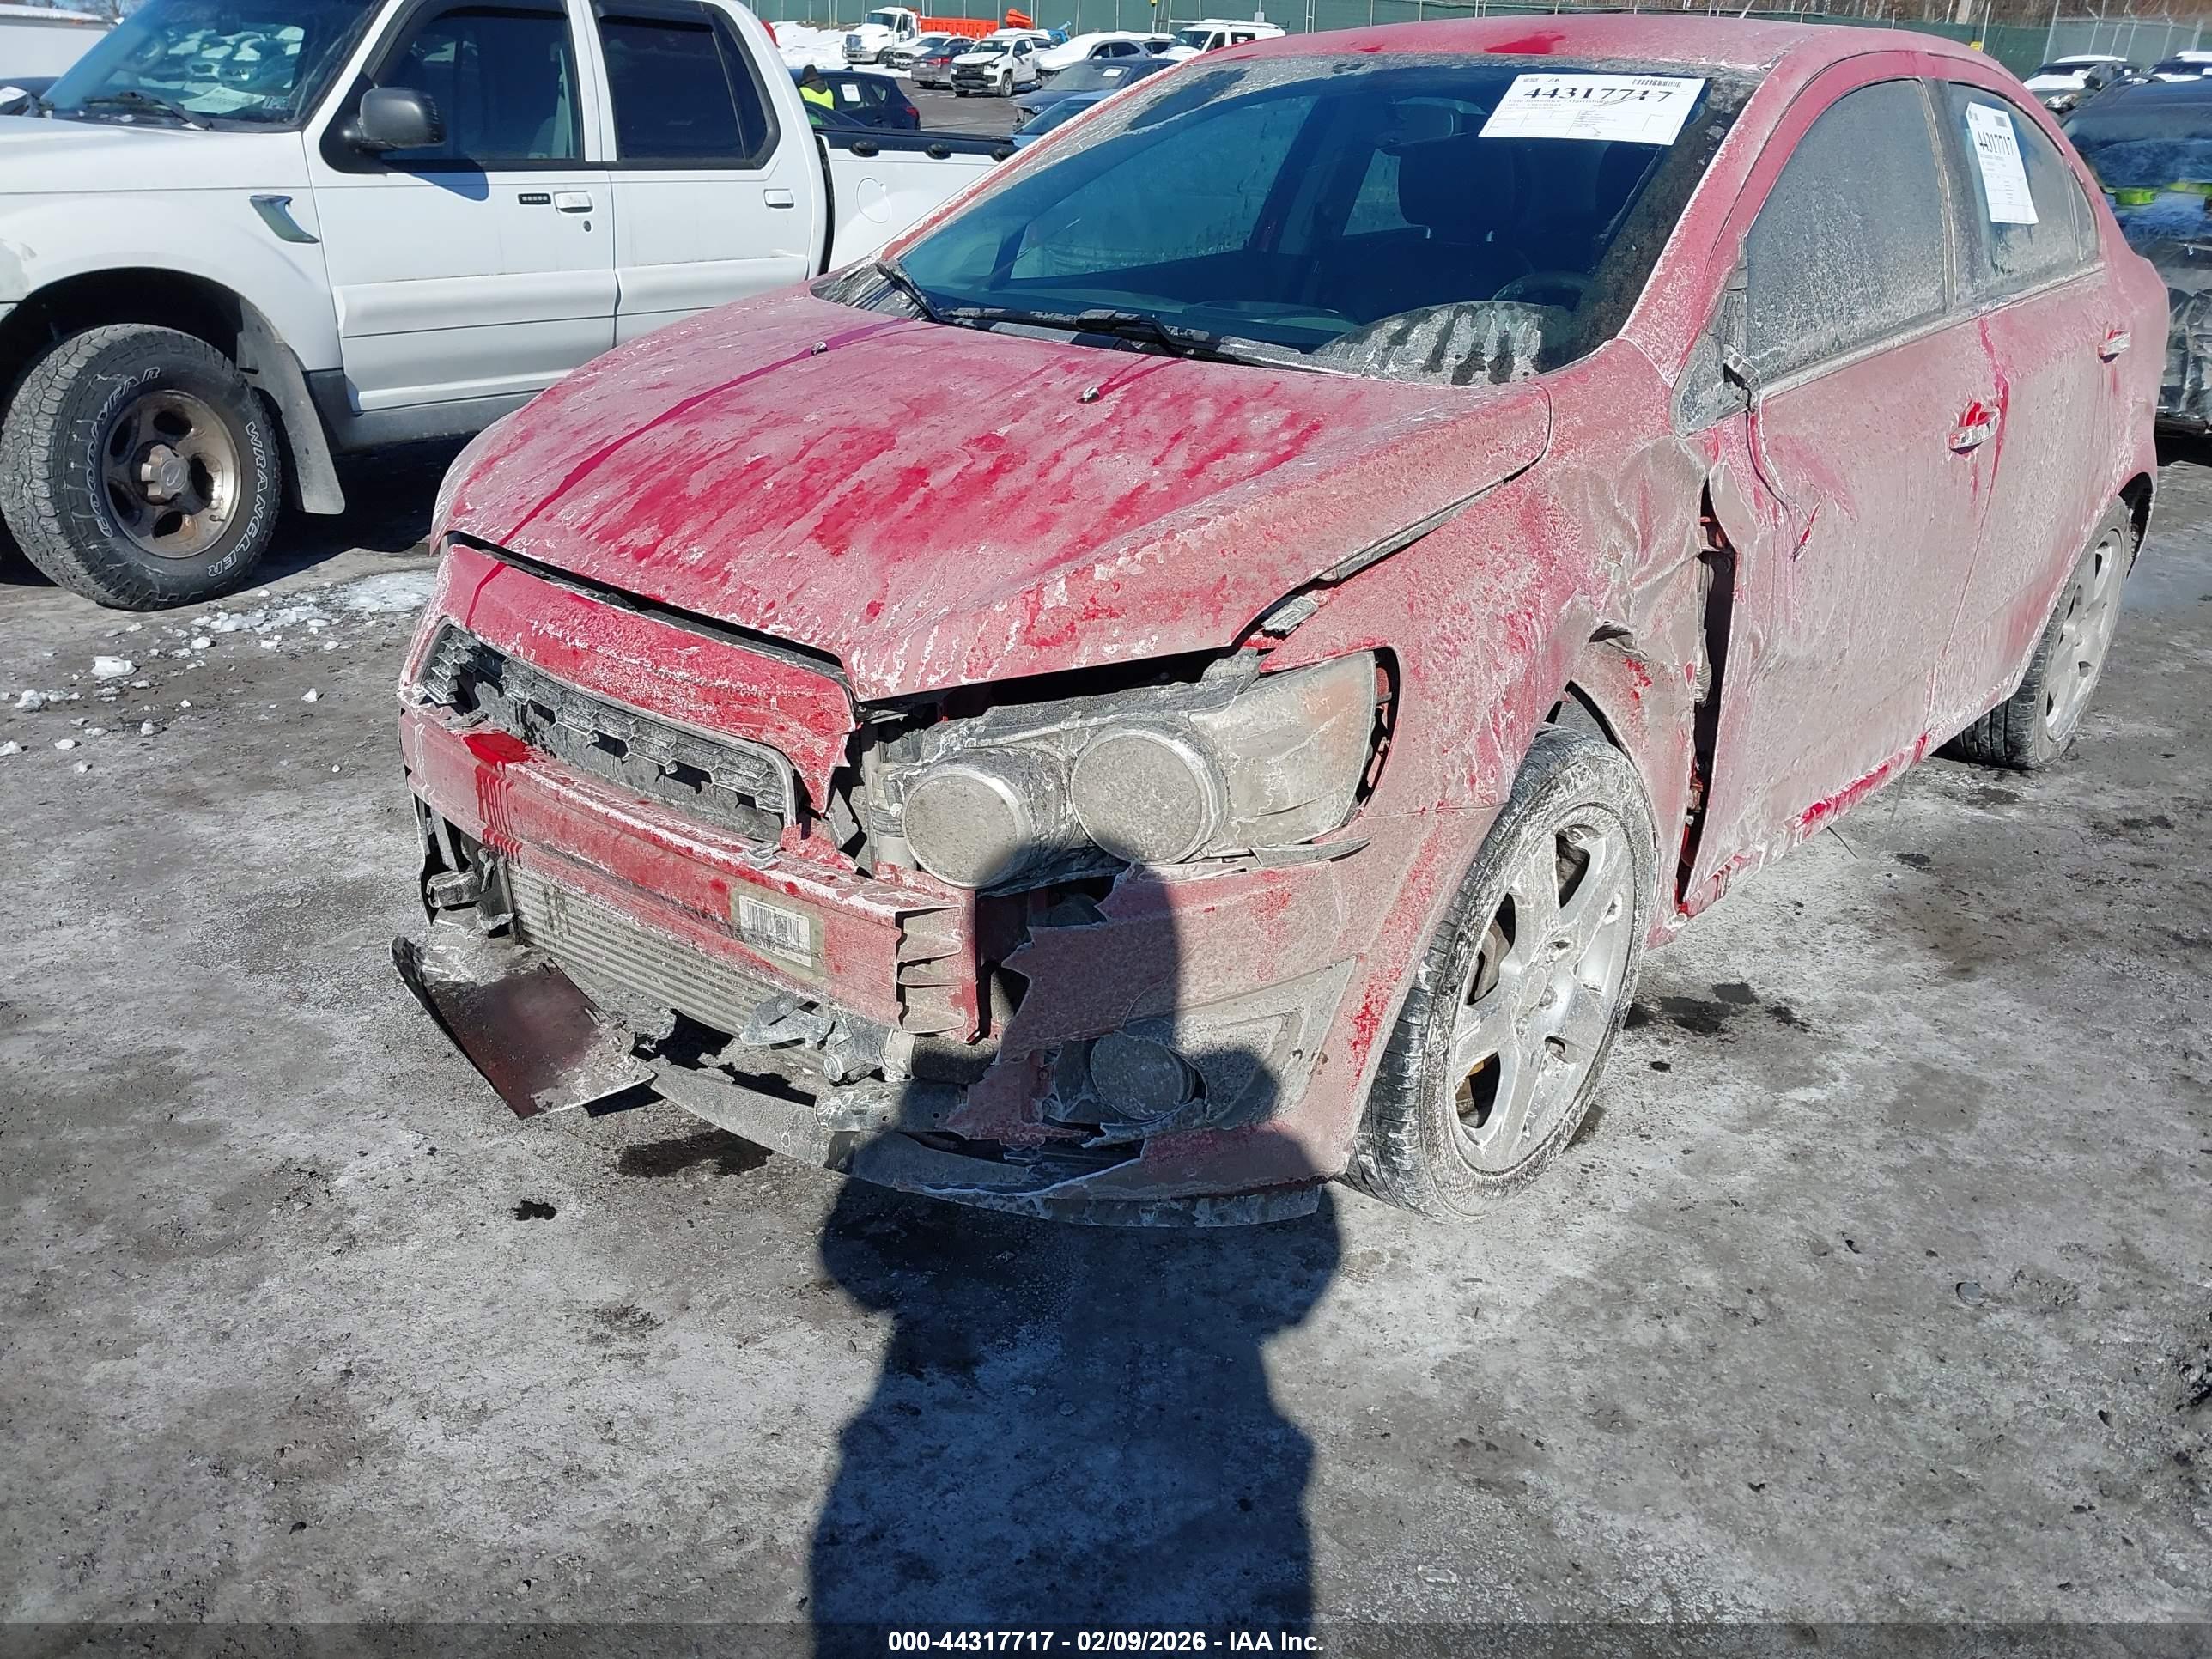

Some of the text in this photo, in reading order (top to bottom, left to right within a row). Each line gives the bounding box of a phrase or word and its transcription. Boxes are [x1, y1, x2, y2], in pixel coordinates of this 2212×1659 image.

[1523, 87, 1673, 103] 44317717
[1978, 131, 2014, 156] 44317717
[206, 421, 269, 577] WRANGLER
